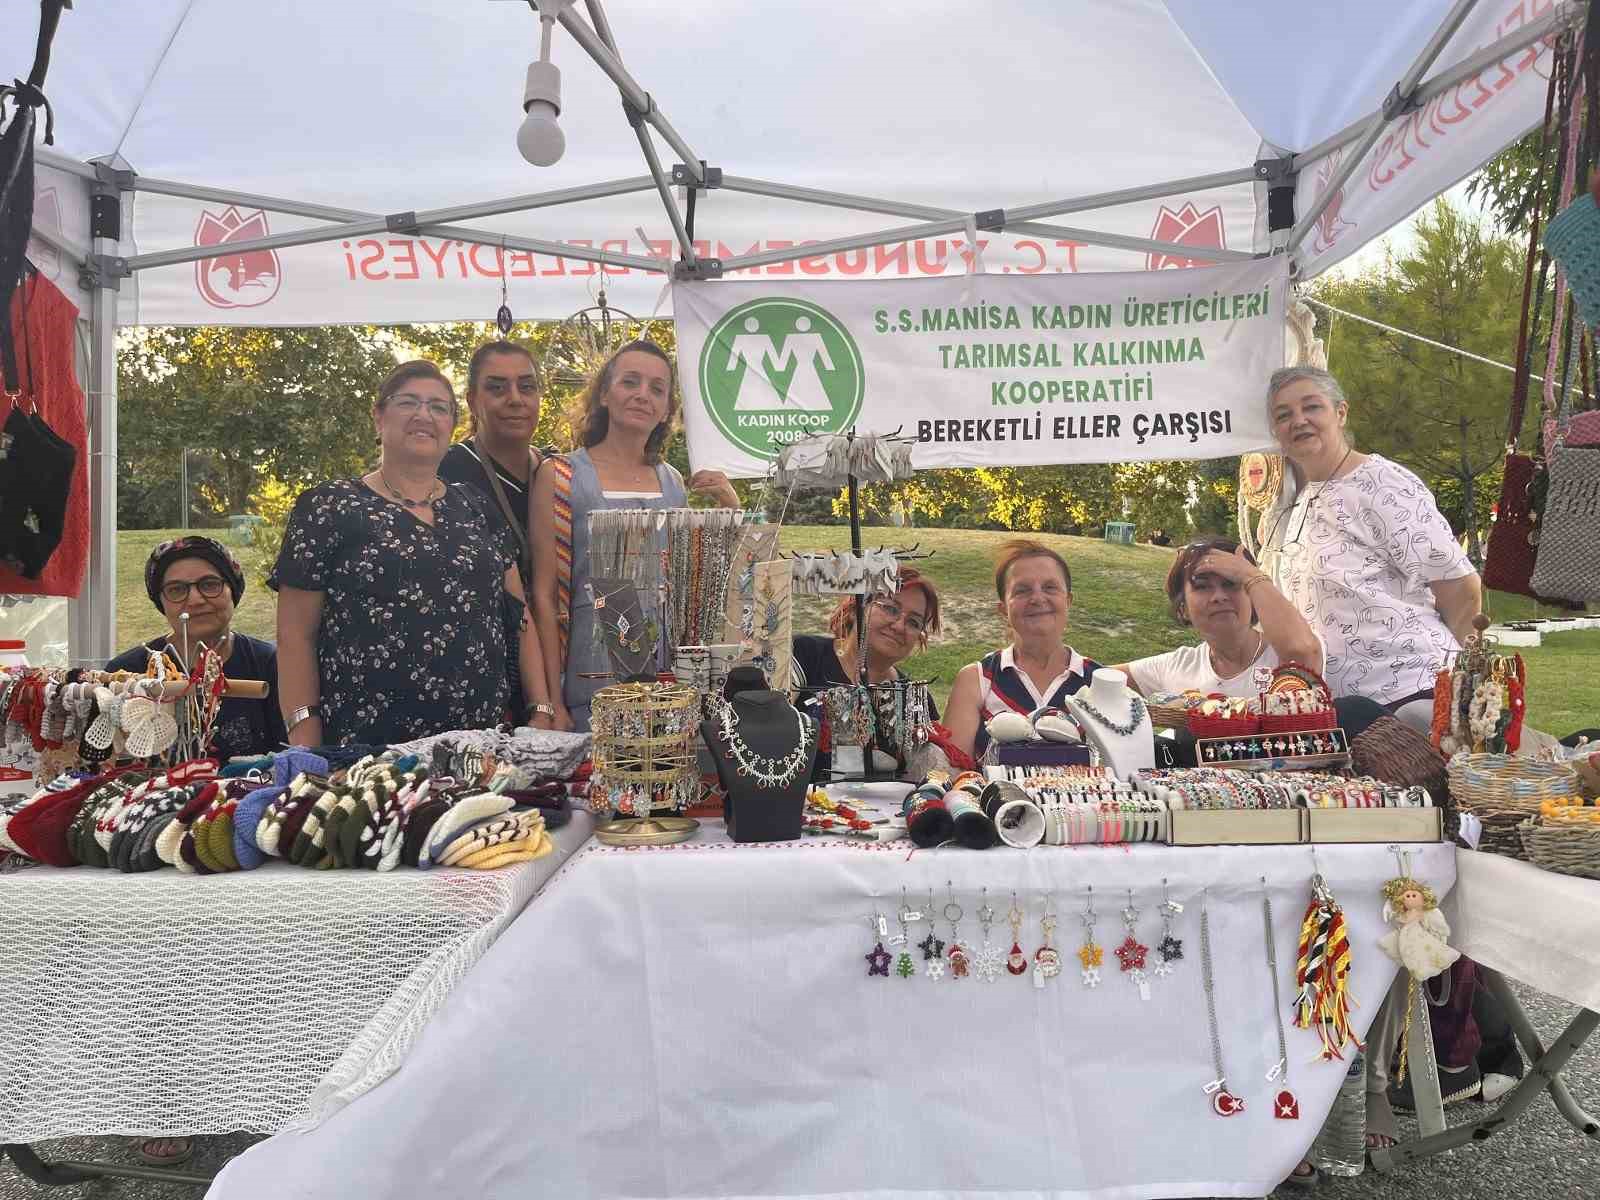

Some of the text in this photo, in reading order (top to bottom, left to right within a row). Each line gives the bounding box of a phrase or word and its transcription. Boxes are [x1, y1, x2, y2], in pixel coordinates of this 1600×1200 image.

[873, 285, 1270, 335] S.S.MANİSA KADIN ÜRETİCİLERİ
[939, 336, 1206, 369] TARIMSAL KALKINMA
[991, 371, 1153, 406] KOOPERATİFİ
[737, 414, 831, 428] KADIN KOOP
[766, 430, 801, 444] 2008
[918, 409, 1233, 445] BEREKETLİ ELLER ÇARŞISI
